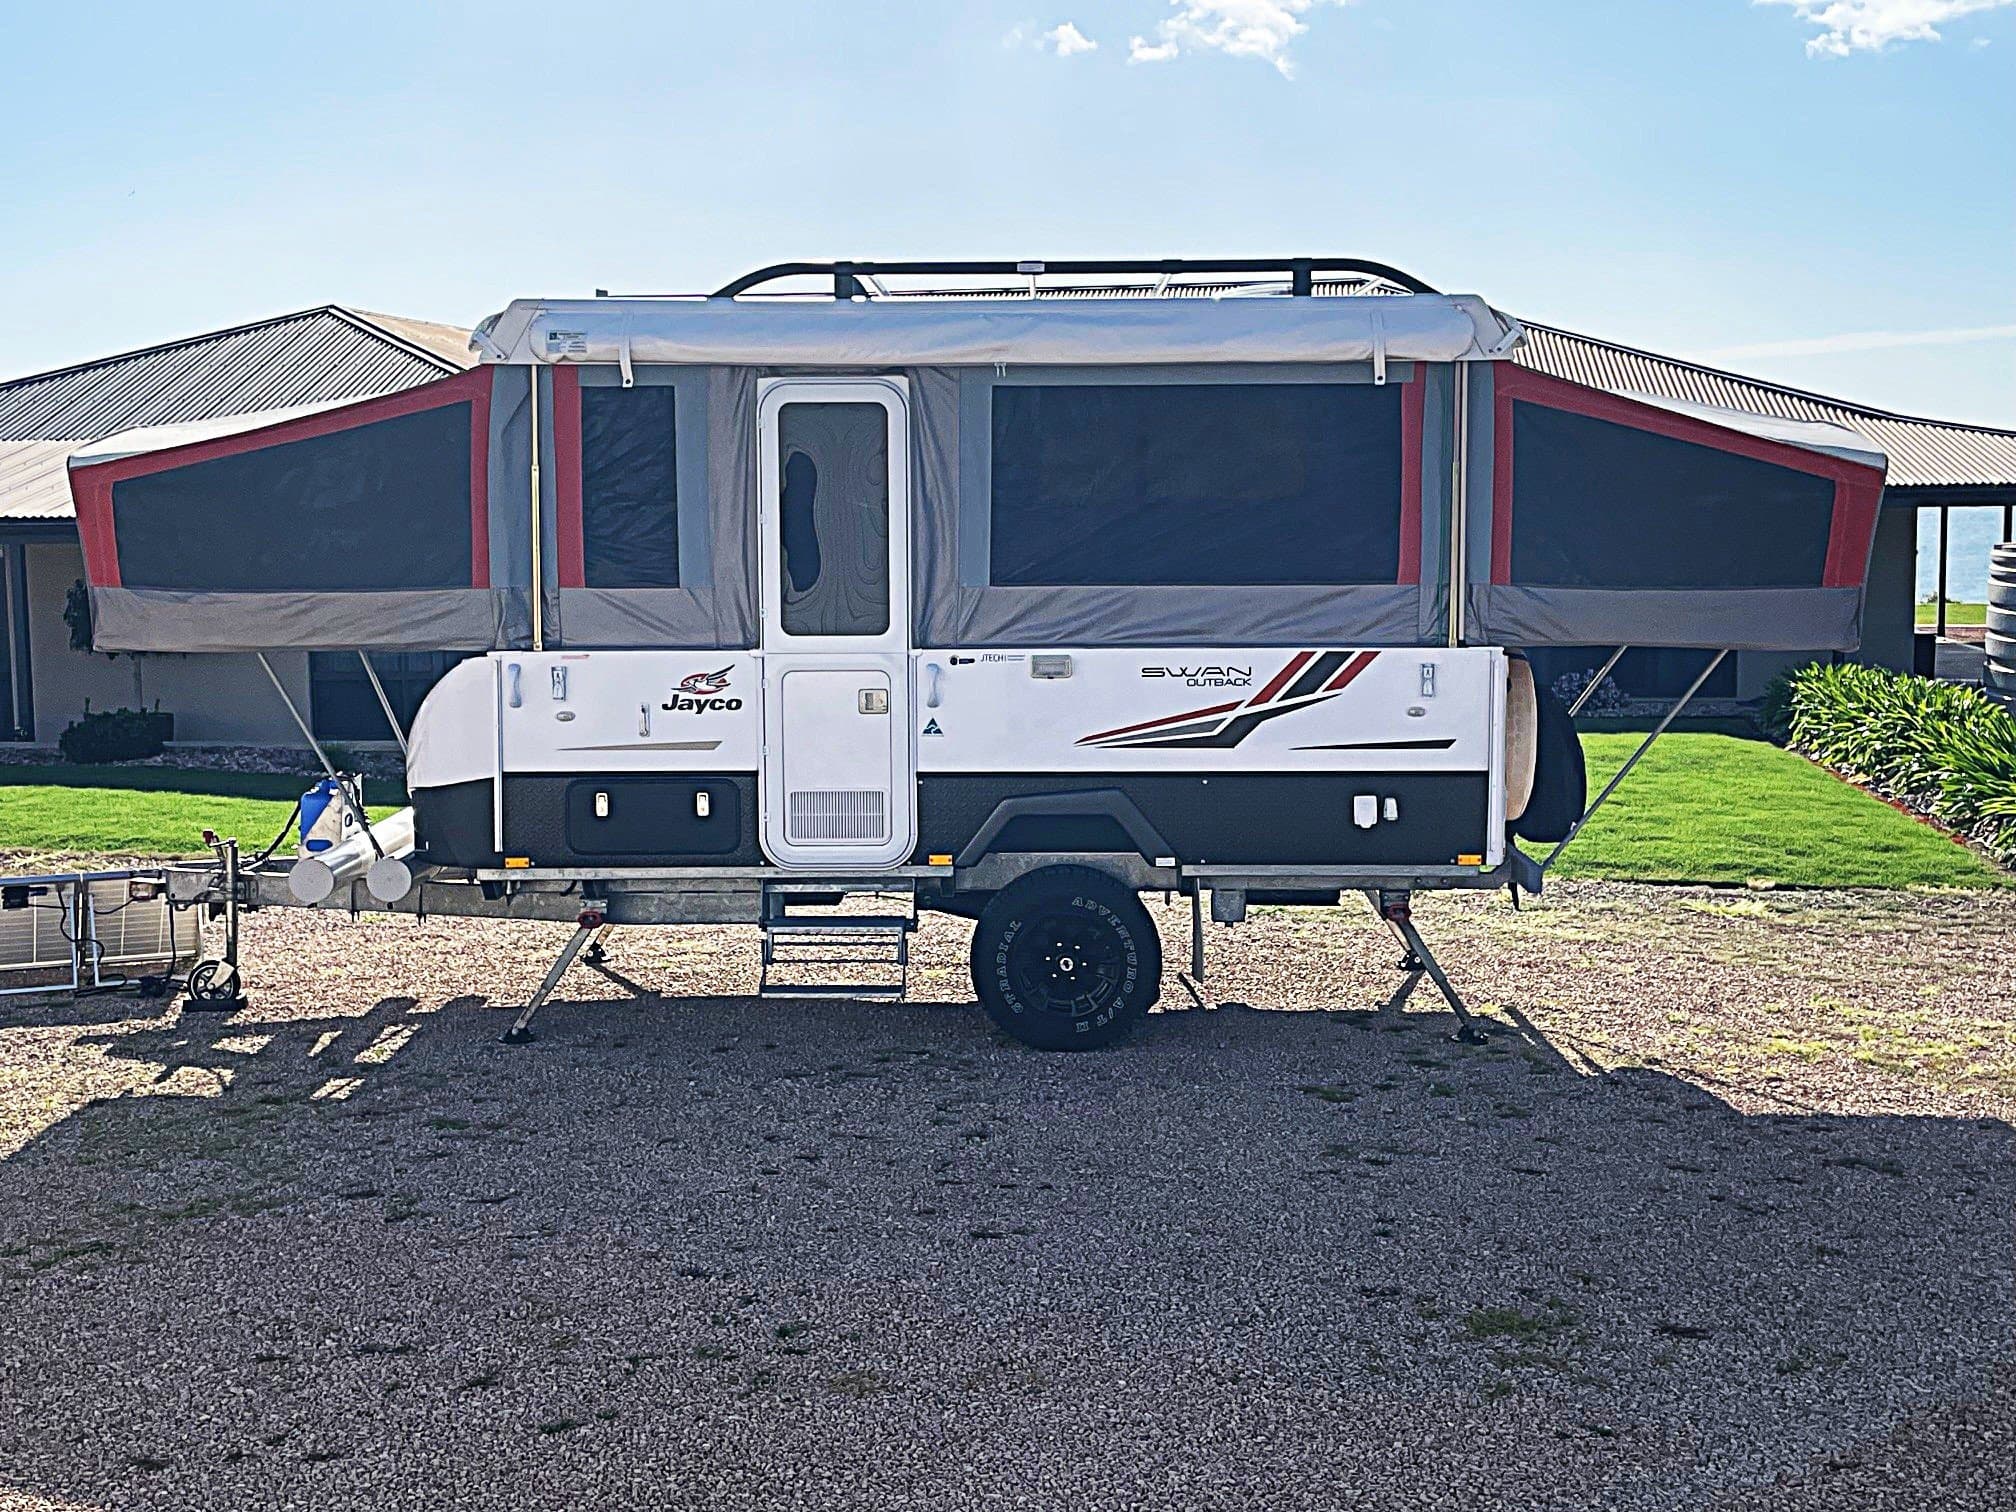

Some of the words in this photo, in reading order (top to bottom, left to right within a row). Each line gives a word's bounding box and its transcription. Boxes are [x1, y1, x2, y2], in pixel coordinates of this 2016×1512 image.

[1141, 666, 1252, 678] SWAN
[1186, 678, 1252, 687] OUTBACK
[661, 693, 743, 715] Jayco
